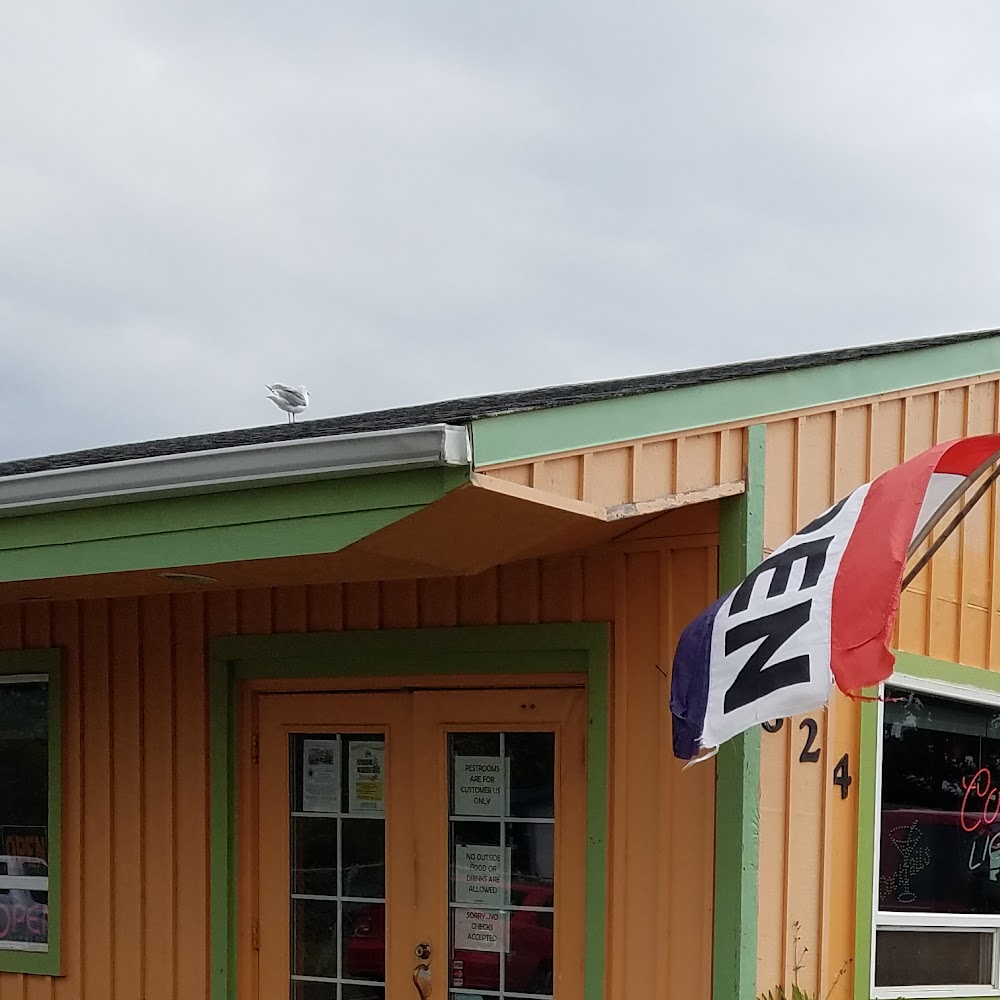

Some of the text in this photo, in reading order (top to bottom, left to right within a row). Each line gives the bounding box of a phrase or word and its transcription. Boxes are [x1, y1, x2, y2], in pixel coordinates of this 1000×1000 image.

[465, 764, 500, 772] RESTROOMS
[470, 775, 495, 783] ARE FOR
[461, 786, 491, 794] CUSTOMER
[473, 797, 491, 805] ONLY
[477, 853, 501, 862] OUTSIDE
[470, 864, 487, 872] FOOD
[471, 923, 494, 931] CHECKS
[467, 933, 498, 942] ACCEPTED
